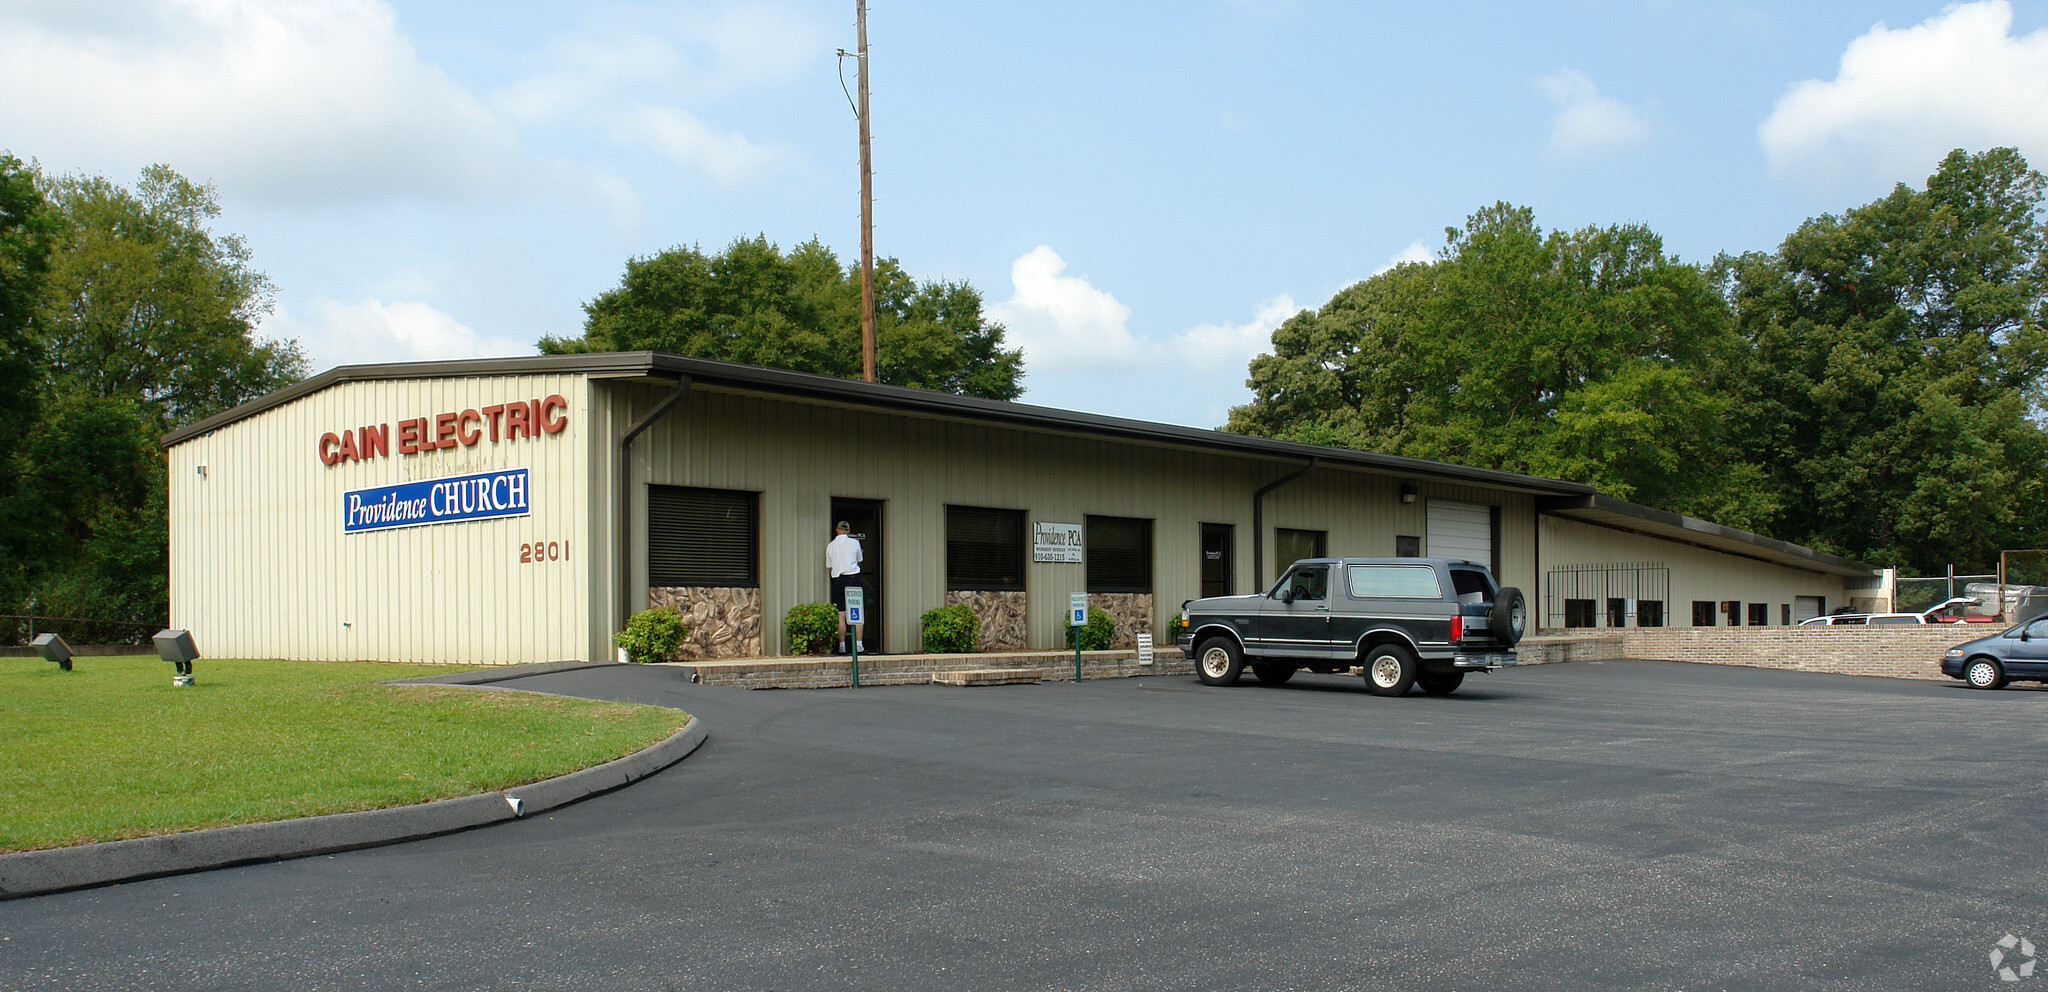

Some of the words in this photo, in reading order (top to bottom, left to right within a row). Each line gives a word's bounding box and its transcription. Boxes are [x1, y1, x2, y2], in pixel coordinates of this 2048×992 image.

[318, 423, 389, 466] CAIN
[398, 394, 568, 455] ELECTRIC
[347, 493, 427, 526] Providence
[430, 473, 527, 516] CHURCH
[520, 540, 569, 563] 2801
[1034, 522, 1066, 546] Providence
[1068, 530, 1082, 546] PCA
